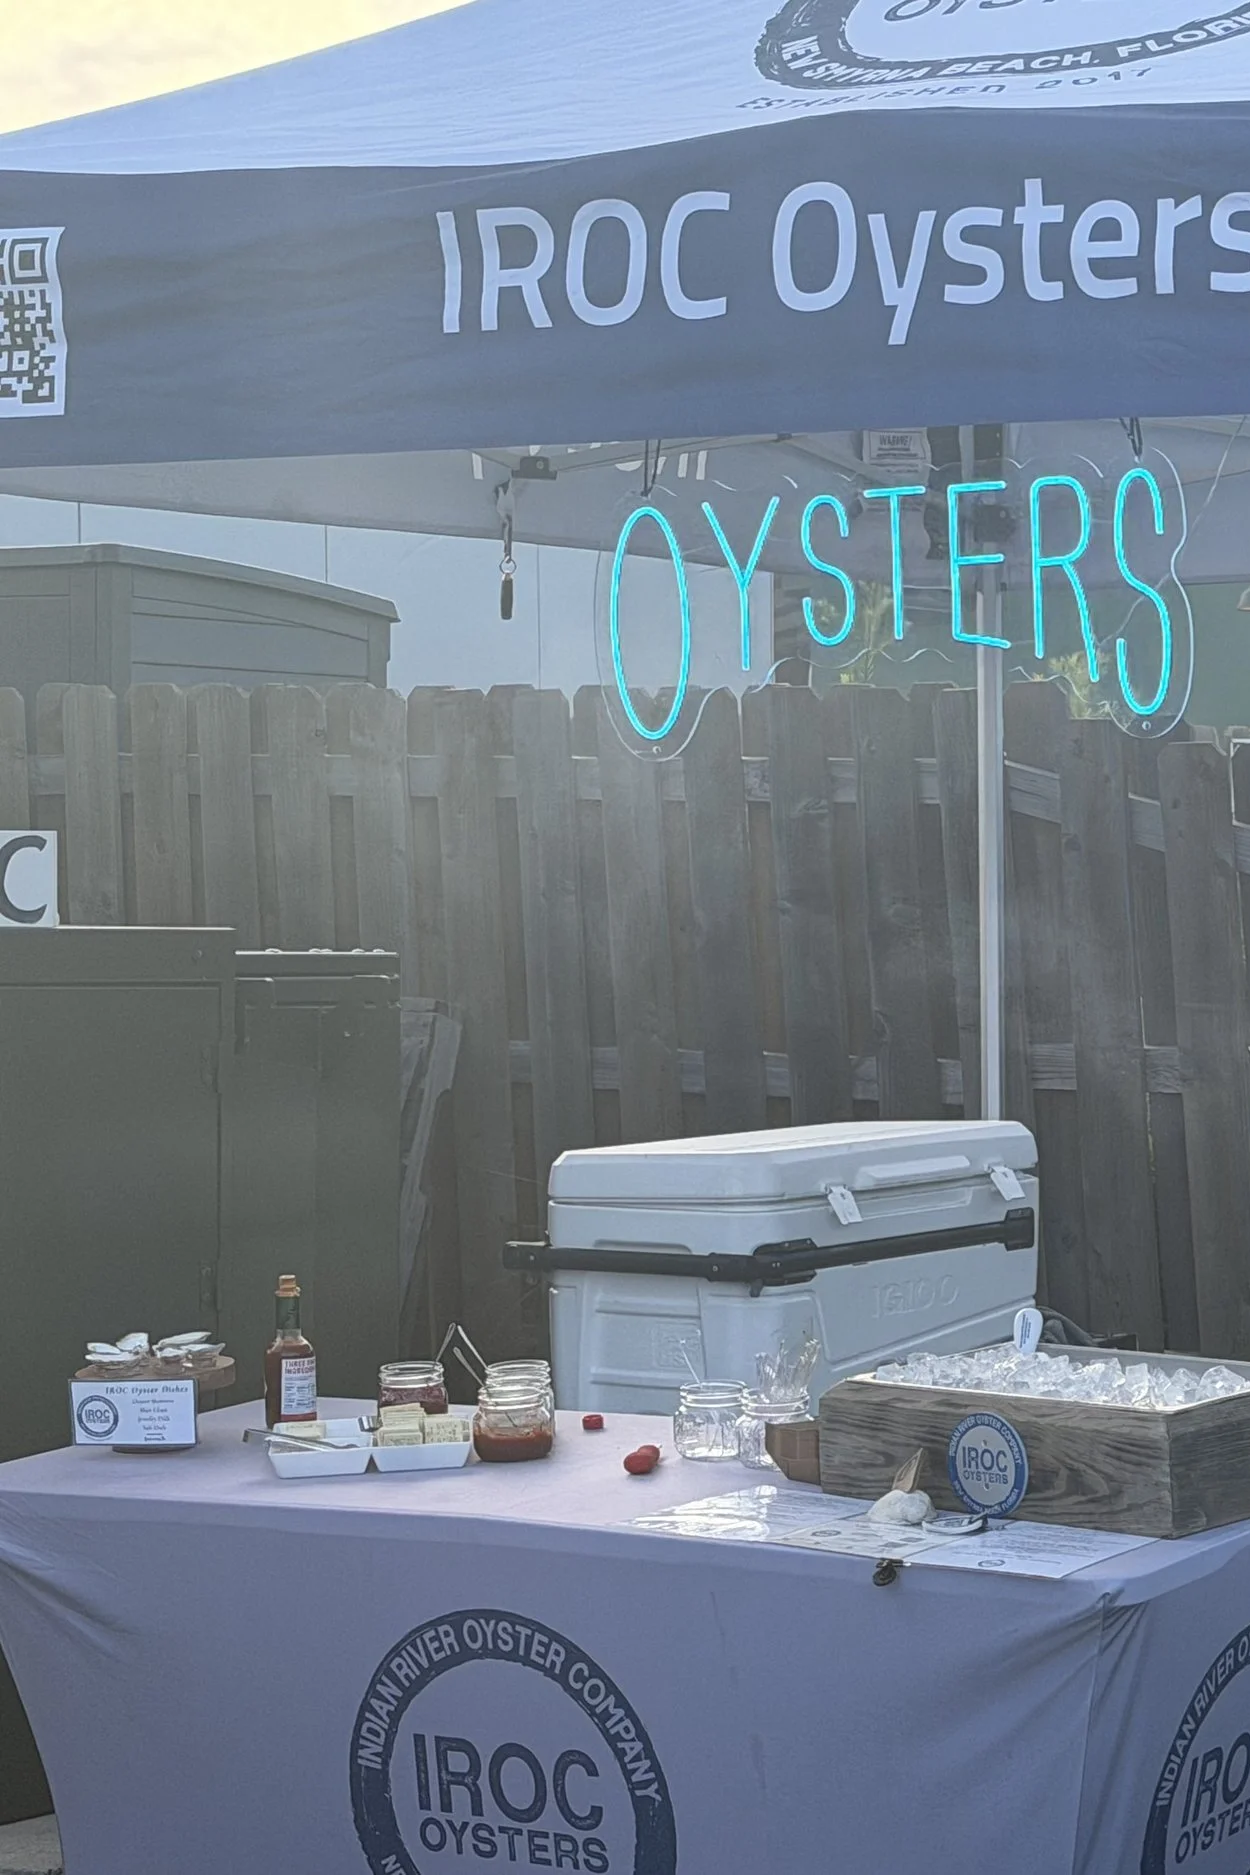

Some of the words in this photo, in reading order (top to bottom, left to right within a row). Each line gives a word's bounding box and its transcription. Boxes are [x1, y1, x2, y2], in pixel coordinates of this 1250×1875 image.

[802, 61, 932, 83] SMYRNA
[1034, 67, 1151, 90] 2017
[435, 190, 731, 334] IROC
[610, 466, 1172, 741] OYSTERS
[84, 1409, 110, 1419] IROC
[975, 1414, 1003, 1430] OYSTER
[961, 1445, 1009, 1474] IROC
[962, 1470, 1009, 1486] OYSTERS
[356, 1675, 403, 1771] INDIAN
[389, 1623, 460, 1688] RIVER
[462, 1617, 567, 1675] OYSTER
[567, 1661, 663, 1808] COMPANY
[1155, 1716, 1197, 1808] INDIAN
[1193, 1648, 1235, 1716] RIVER
[412, 1732, 604, 1832] IROC
[418, 1816, 610, 1875] OYSTERS
